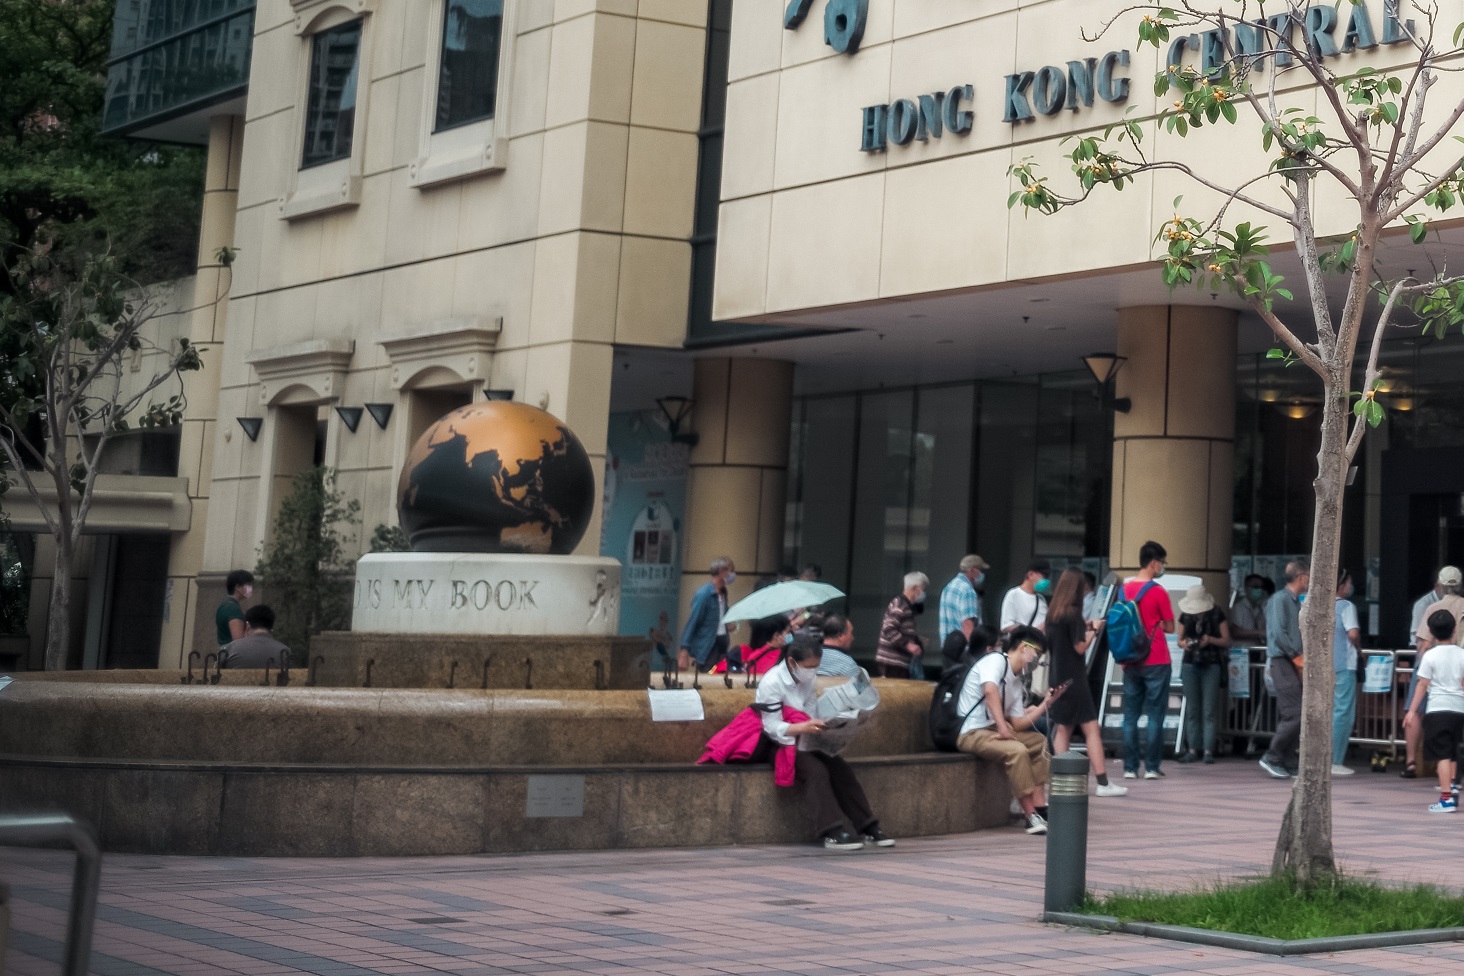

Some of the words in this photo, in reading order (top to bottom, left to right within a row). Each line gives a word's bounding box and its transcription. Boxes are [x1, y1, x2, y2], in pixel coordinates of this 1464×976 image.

[859, 84, 975, 152] HONG
[1002, 49, 1131, 123] KONG
[367, 579, 382, 610] IS
[391, 579, 434, 610] MY
[449, 579, 540, 611] BOOK
